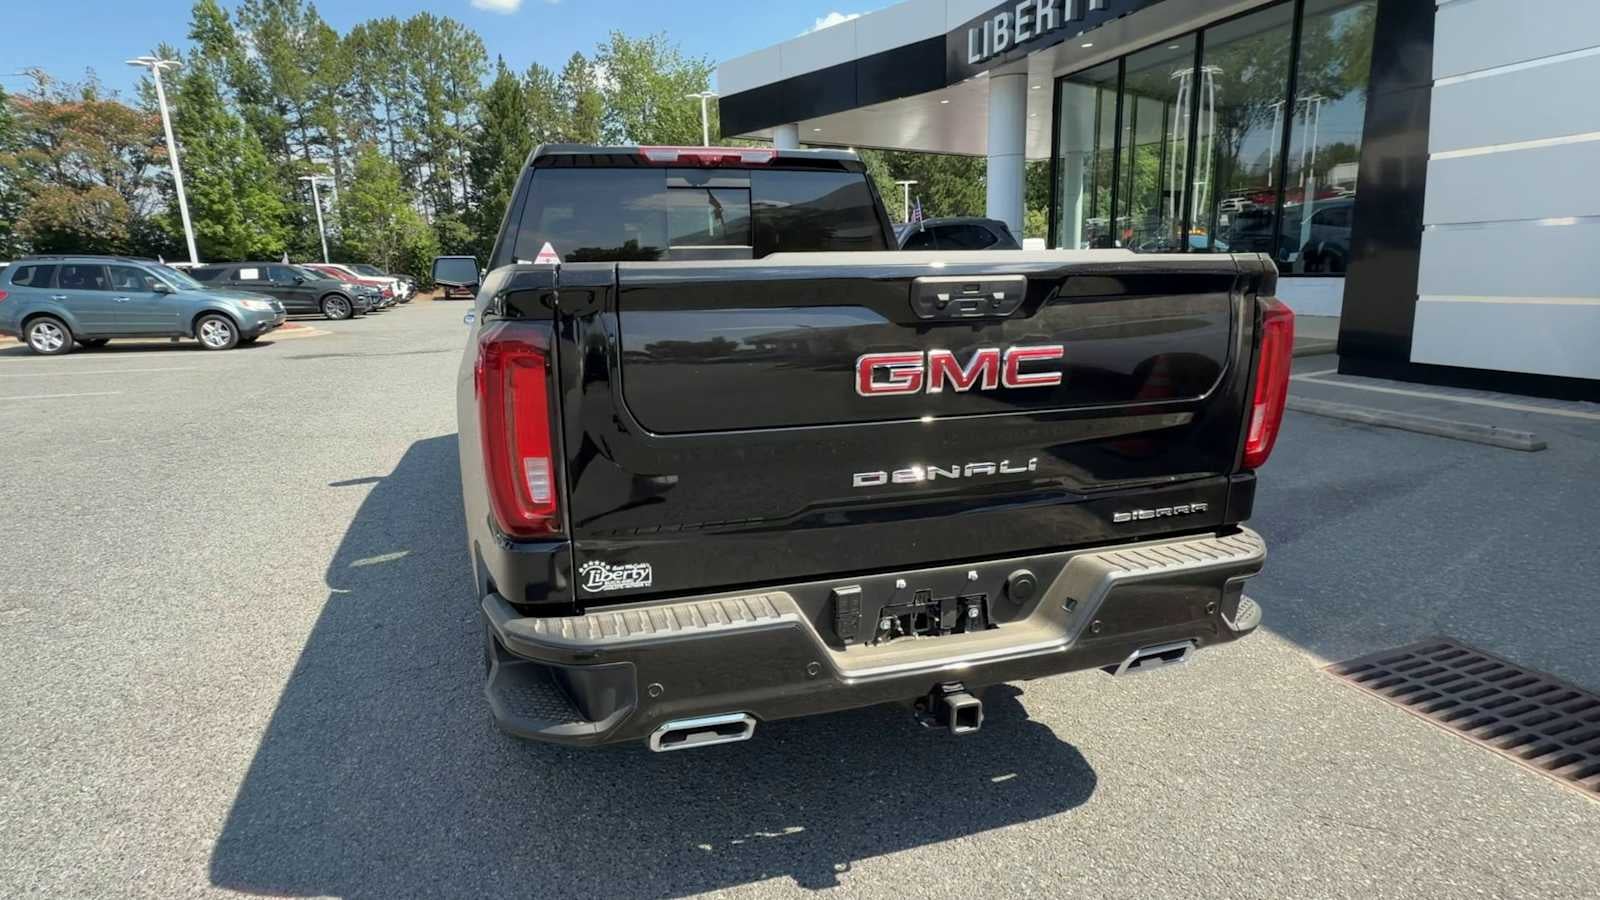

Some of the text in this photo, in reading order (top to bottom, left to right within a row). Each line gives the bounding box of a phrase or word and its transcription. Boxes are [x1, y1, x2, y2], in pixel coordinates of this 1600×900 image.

[968, 0, 1103, 64] LIBER
[856, 345, 1064, 396] GMC
[853, 457, 1038, 487] DENALI
[1113, 503, 1208, 522] SIERRA
[587, 568, 649, 587] Liberty
